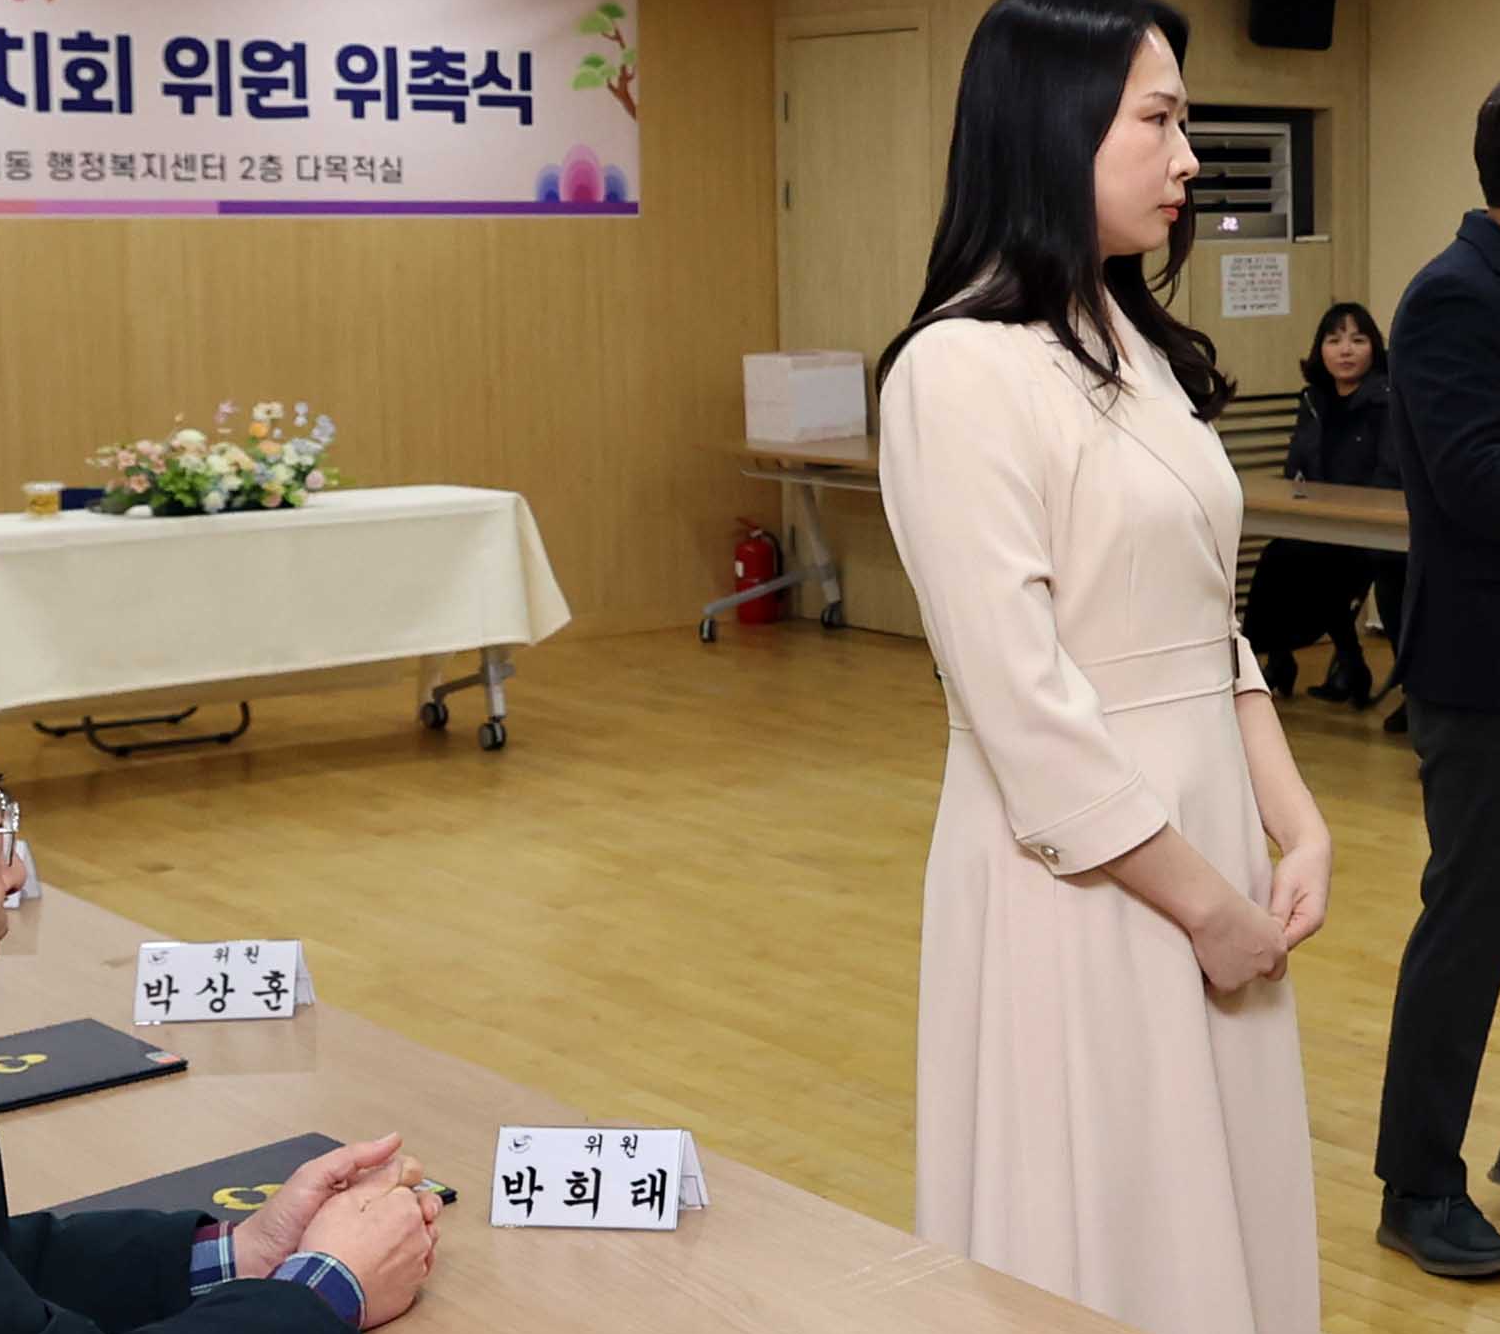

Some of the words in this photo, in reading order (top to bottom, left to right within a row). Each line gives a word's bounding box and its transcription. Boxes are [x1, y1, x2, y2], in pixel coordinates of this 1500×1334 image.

[161, 36, 311, 121] 위원
[334, 44, 534, 126] 위촉식
[47, 151, 226, 183] 행정복지센터
[239, 154, 284, 184] 2층
[296, 155, 403, 184] 다목적실
